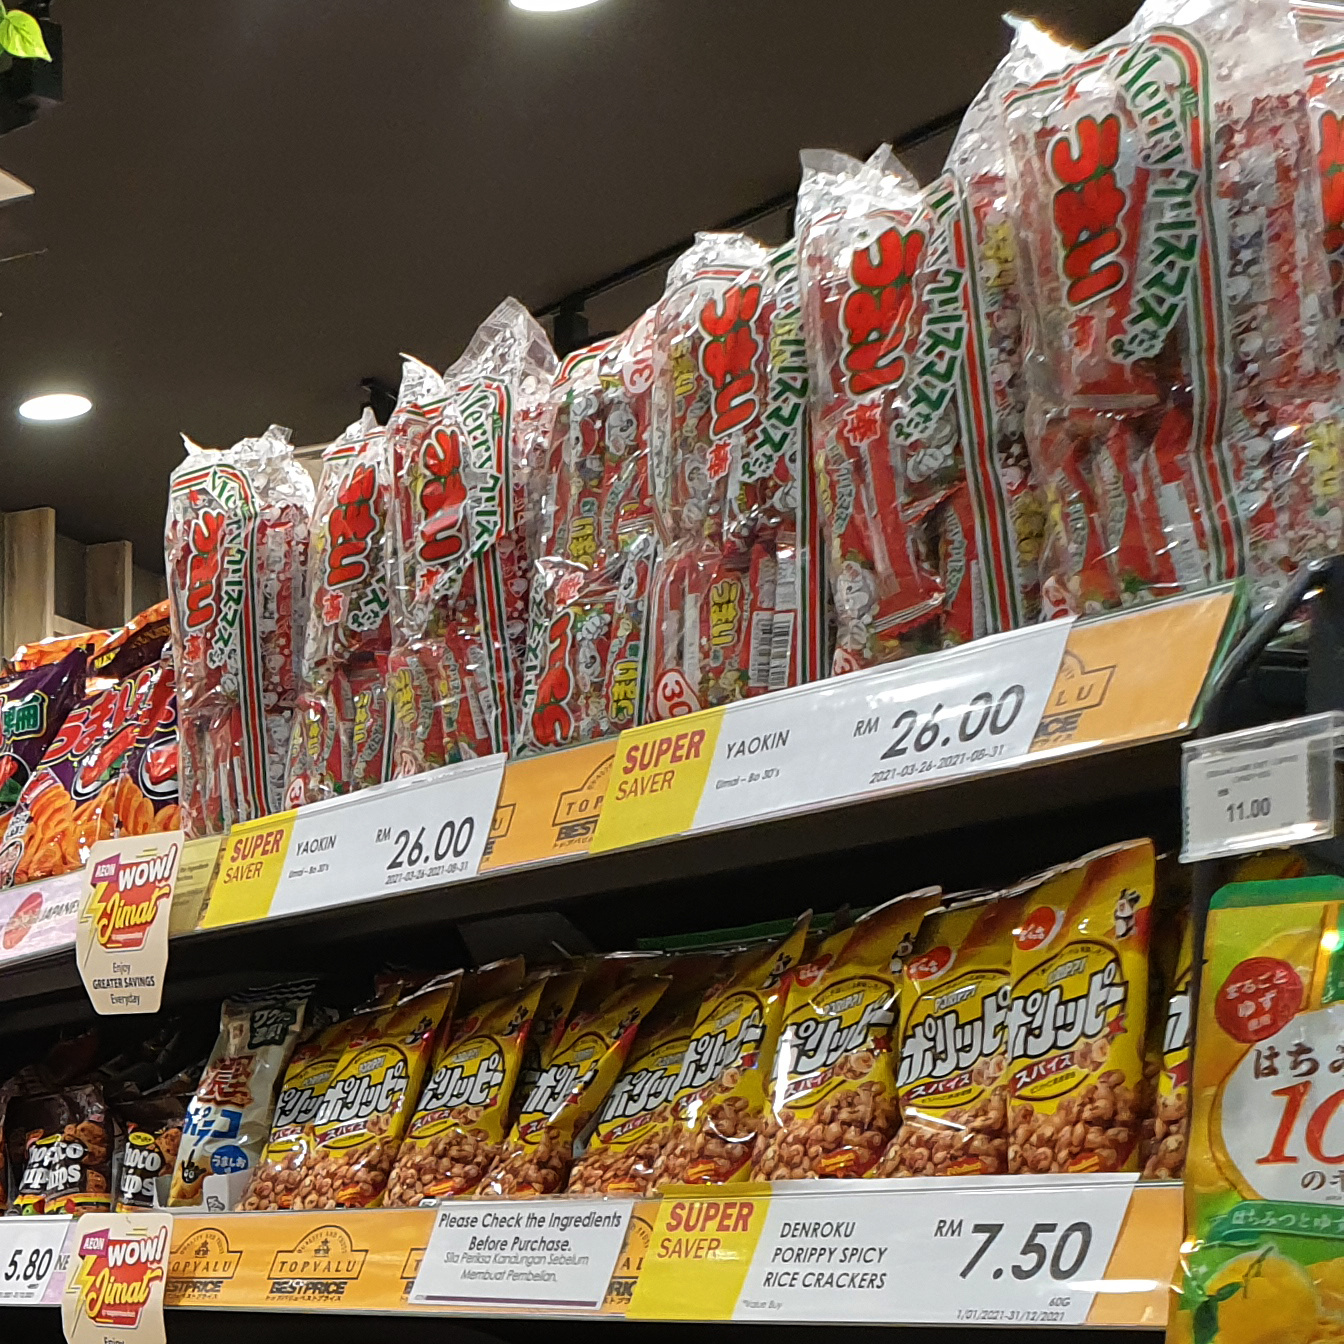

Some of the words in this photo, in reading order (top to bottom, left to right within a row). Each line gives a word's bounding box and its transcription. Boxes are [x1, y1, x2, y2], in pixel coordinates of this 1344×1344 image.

[725, 730, 791, 761] YAOKIN
[853, 716, 880, 738] RM
[880, 685, 1026, 763] 26.00
[623, 728, 706, 776] SUPER
[615, 768, 676, 801] SAVER
[1224, 796, 1272, 824] 11.00
[230, 829, 285, 863] SUPER
[295, 835, 338, 857] YAOKIN
[375, 826, 392, 844] RM
[386, 816, 476, 872] 26.00
[95, 863, 117, 878] AEON
[118, 843, 178, 891] WOW!
[223, 861, 265, 885] SAVER
[98, 885, 172, 944] Jimat
[112, 961, 131, 974] Enjoy
[93, 977, 123, 990] GREATER
[124, 976, 156, 988] SAVINGS
[110, 993, 140, 1007] Everyday
[1011, 962, 1128, 1059] ポリッピー
[1015, 1053, 1073, 1086] スパイス
[910, 1073, 972, 1098] スパイス
[438, 1212, 479, 1230] Please
[480, 1212, 524, 1230] Check
[525, 1213, 547, 1229] the
[548, 1212, 622, 1232] Ingredients
[666, 1201, 755, 1234] SUPER
[82, 1236, 106, 1252] AEON
[107, 1226, 168, 1268] WOW!
[468, 1236, 508, 1252] Before
[510, 1236, 573, 1253] Purchase.
[656, 1236, 723, 1261] SAVER
[771, 1246, 838, 1264] PORIPPY
[838, 1246, 889, 1264] SPICY
[779, 1221, 856, 1239] DENROKU
[934, 1218, 964, 1239] RM
[958, 1220, 1094, 1282] 7.50
[4, 1247, 54, 1282] 5.80
[278, 1259, 358, 1274] TOPVALU
[443, 1252, 460, 1266] Sila
[492, 1253, 547, 1268] Kandungan
[460, 1269, 506, 1281] Membuat
[762, 1271, 799, 1289] RICE
[801, 1271, 888, 1290] CRACKERS
[956, 1309, 1066, 1322] 1/01/2021-31/12/2021
